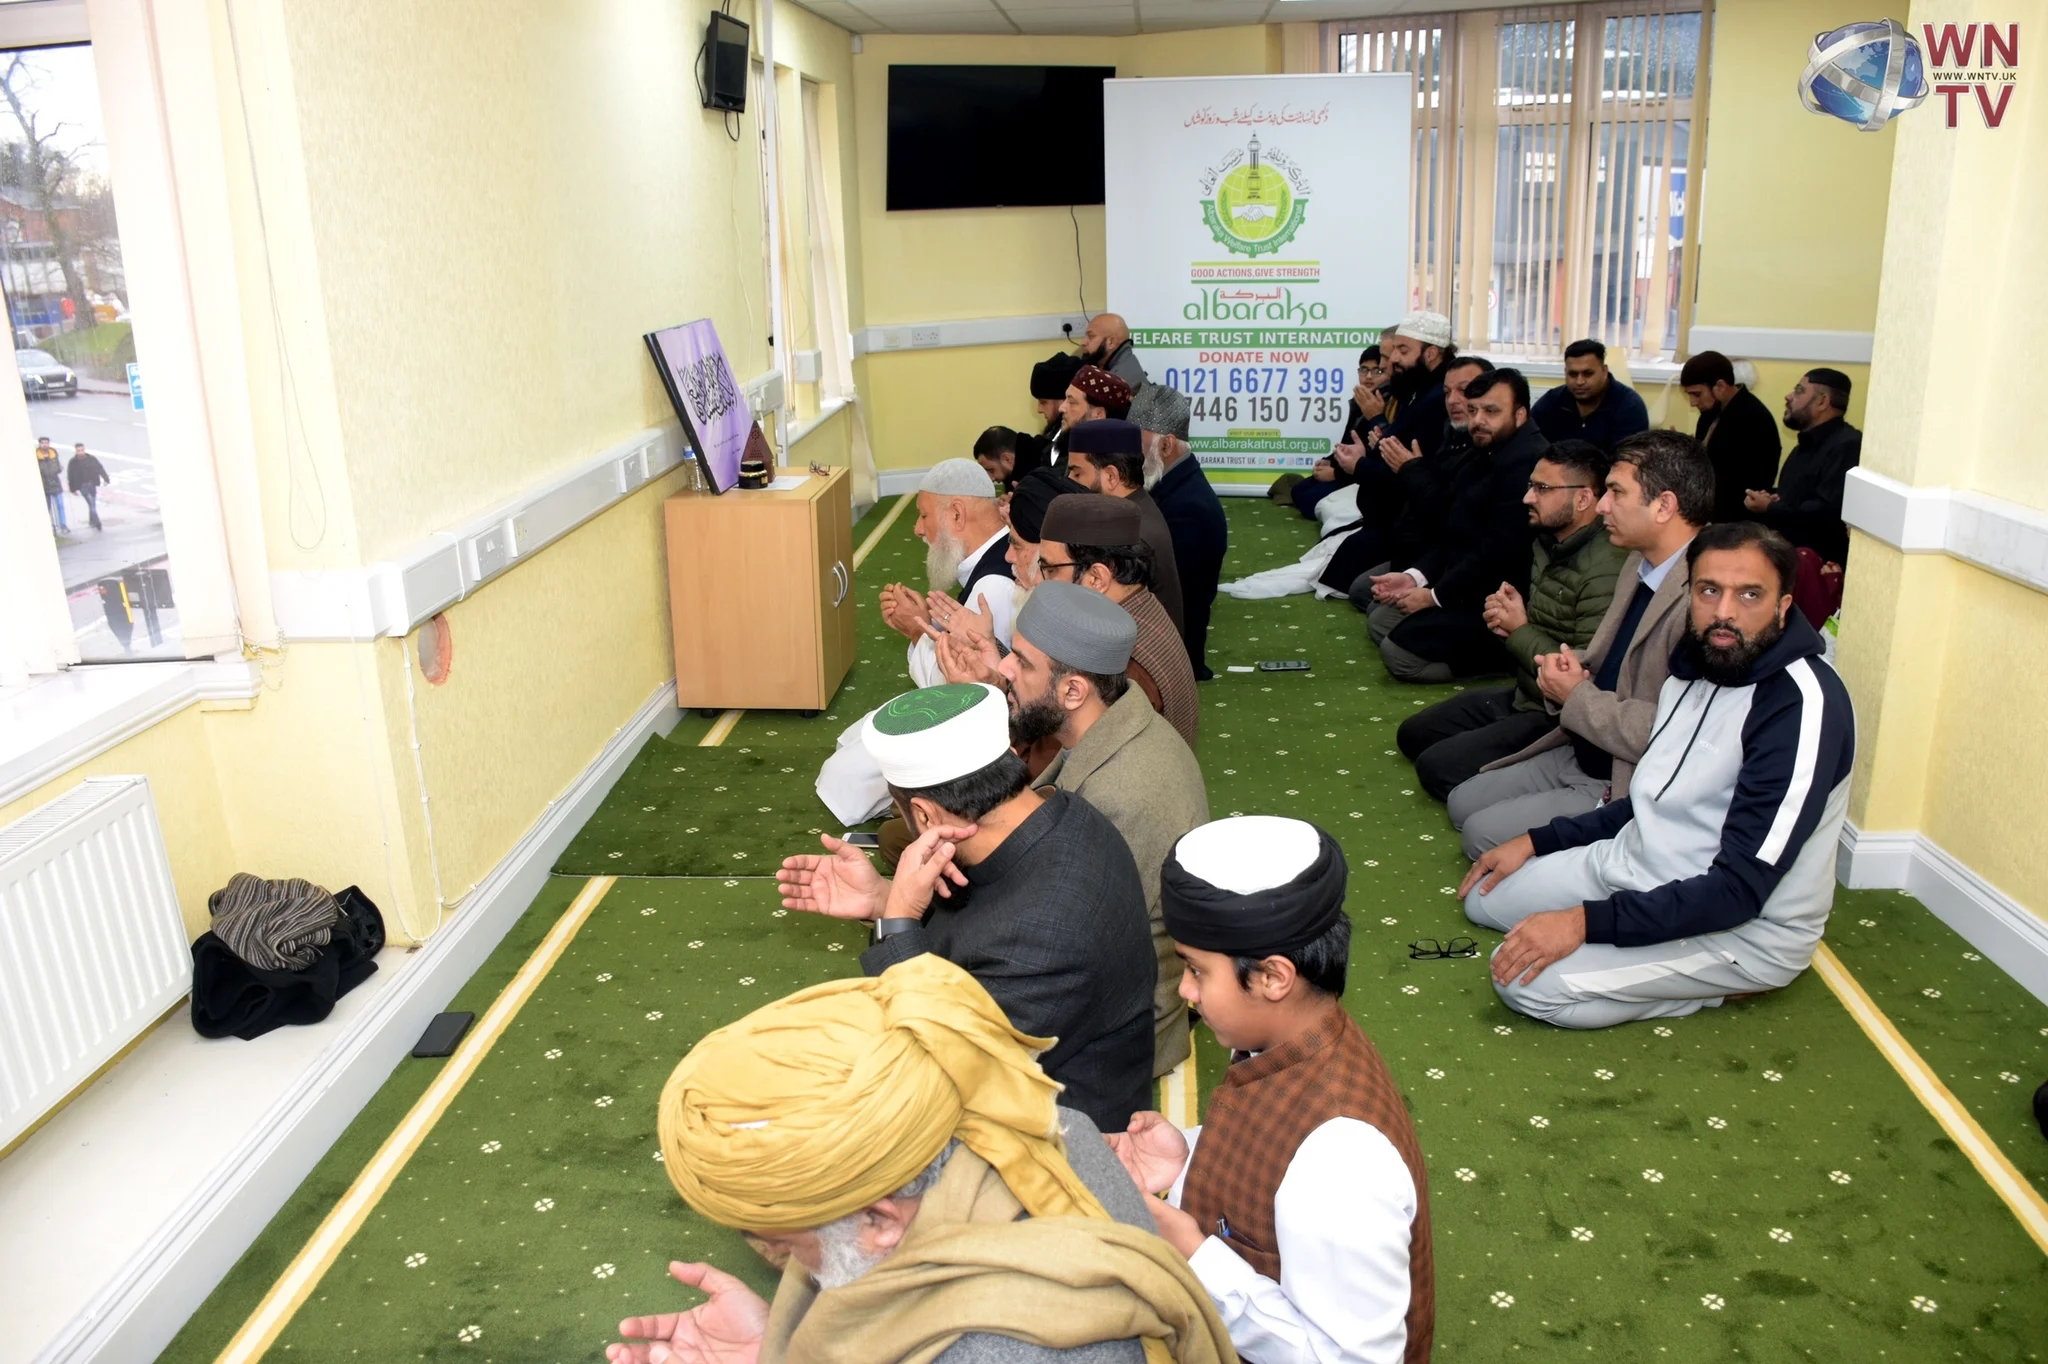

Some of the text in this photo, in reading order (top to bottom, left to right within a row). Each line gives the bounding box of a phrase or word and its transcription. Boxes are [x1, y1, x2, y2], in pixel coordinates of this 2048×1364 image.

[1191, 268, 1215, 278] GOOD
[1276, 268, 1320, 278] STRENGTH
[1183, 287, 1327, 326] albaraka
[1128, 331, 1382, 346] ELFARE TRUST INTERNATIONA
[1200, 352, 1310, 364] DONATE NOW
[1166, 368, 1344, 394] 0121 6677 399
[1248, 397, 1289, 422] 150
[1300, 397, 1342, 422] 735
